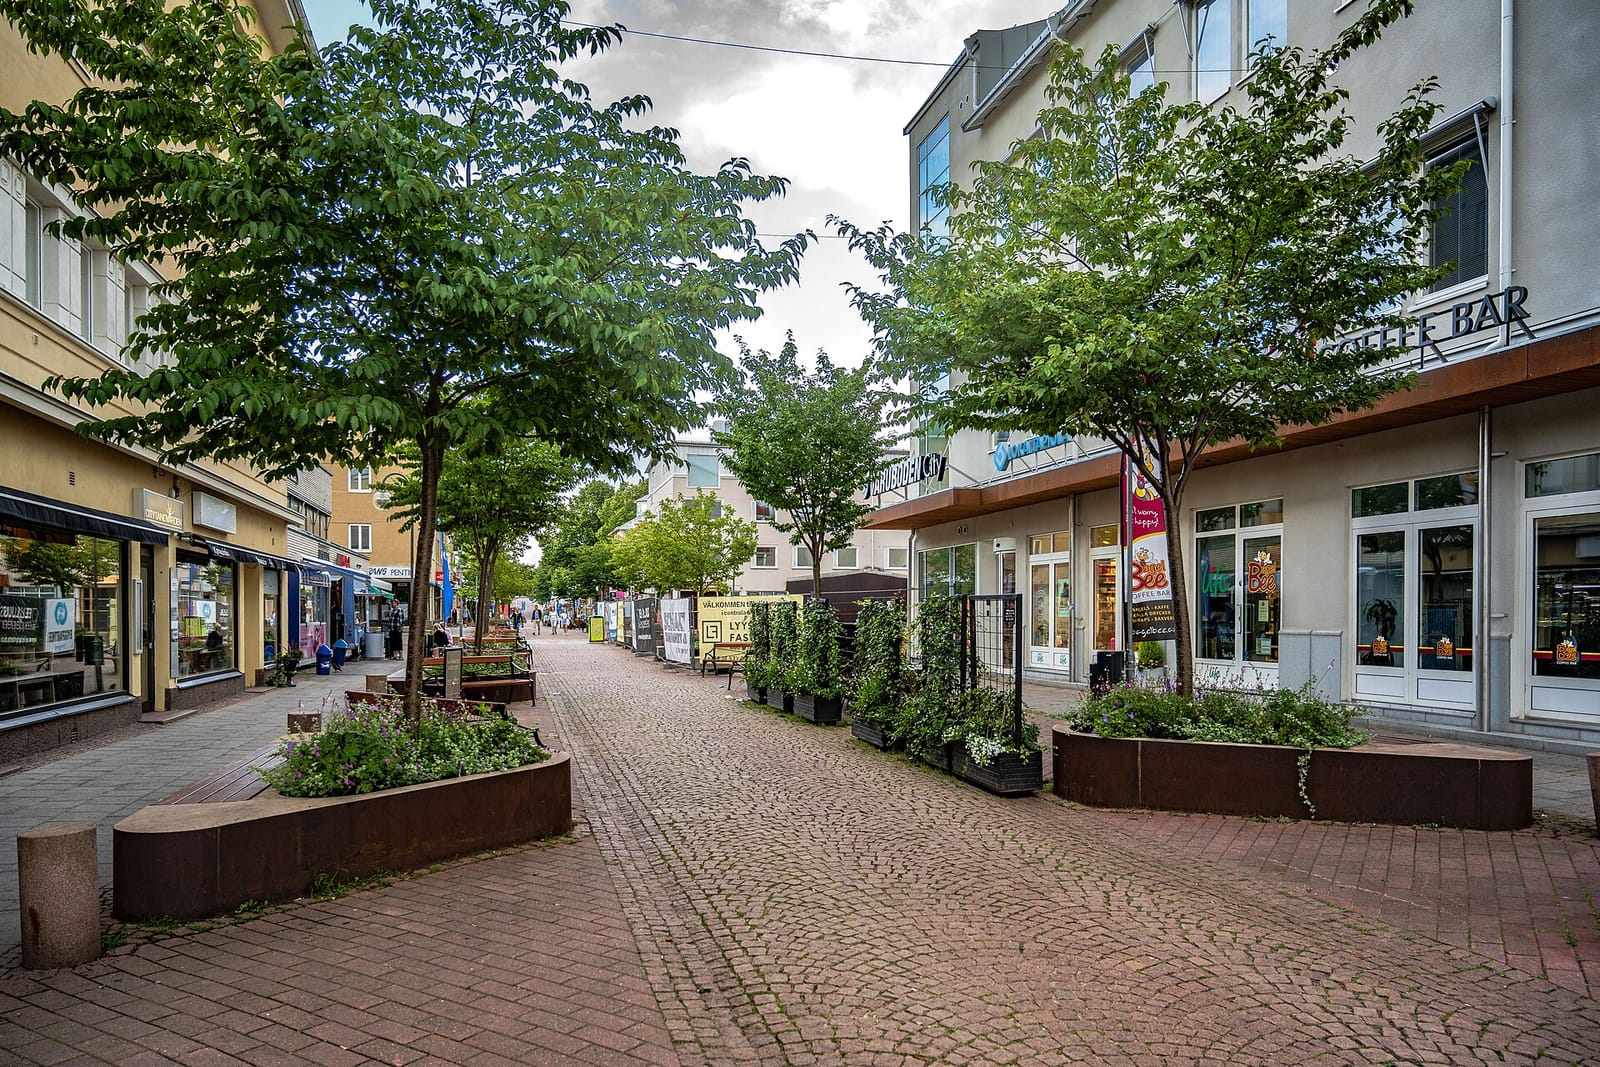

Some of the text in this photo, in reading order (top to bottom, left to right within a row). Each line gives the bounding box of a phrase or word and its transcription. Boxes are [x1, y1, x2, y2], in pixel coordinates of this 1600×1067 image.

[1452, 286, 1531, 337] BAR
[923, 453, 946, 481] City
[1137, 509, 1158, 518] worry
[1134, 517, 1159, 528] happy!
[1249, 561, 1277, 593] Bee
[1132, 589, 1170, 600] OFFEE BAR
[703, 600, 745, 609] VÄLKOMMEN
